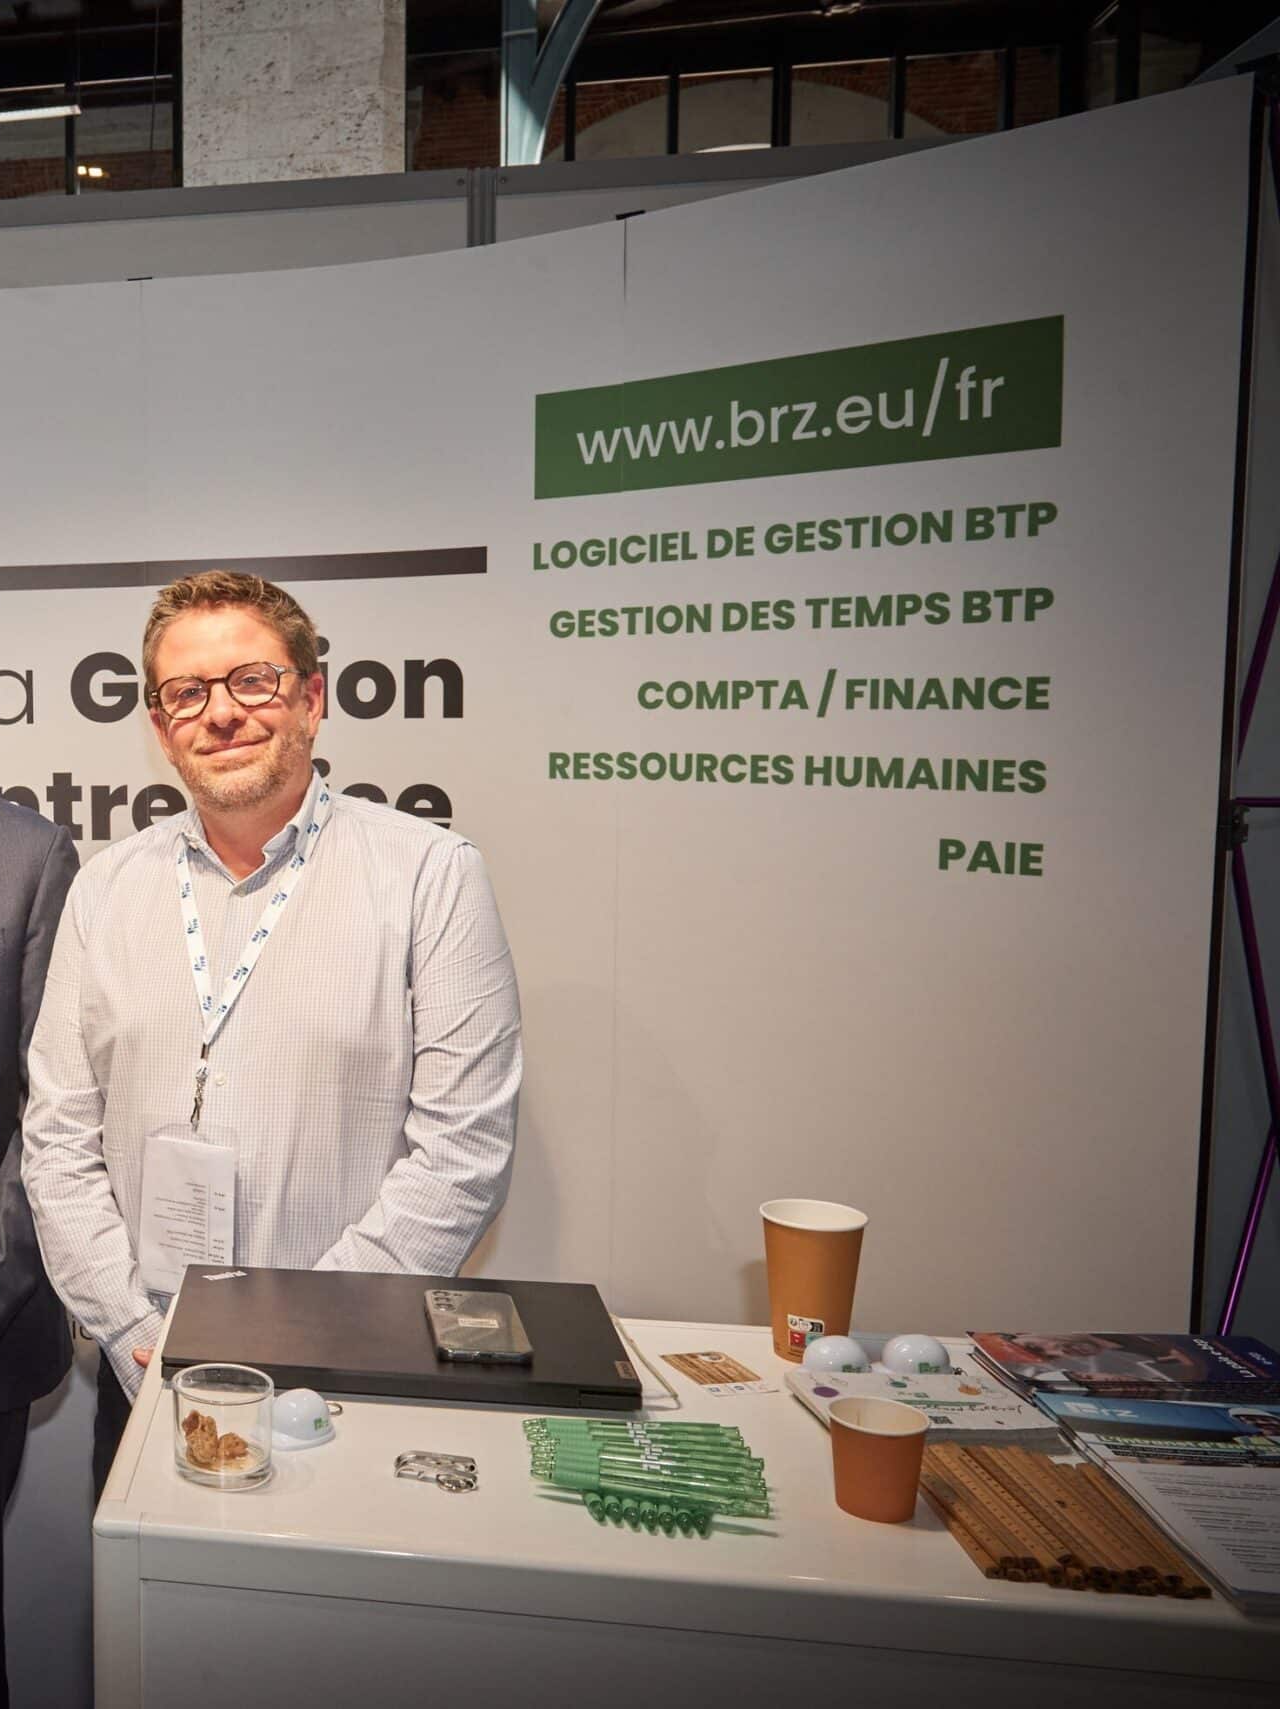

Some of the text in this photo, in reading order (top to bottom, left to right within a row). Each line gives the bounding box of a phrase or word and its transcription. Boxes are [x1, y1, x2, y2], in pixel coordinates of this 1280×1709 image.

[575, 356, 1006, 467] www.brz.eu/fr
[532, 501, 1058, 571] LOGICIEL DE GESTION BTP
[549, 587, 1055, 639] GESTION DES TEMPS BTP
[637, 679, 809, 711] COMPTA
[845, 676, 1051, 711] FINANCE
[548, 751, 1048, 794] RESSOURCES HUMAINES
[938, 838, 1045, 877] PAIE
